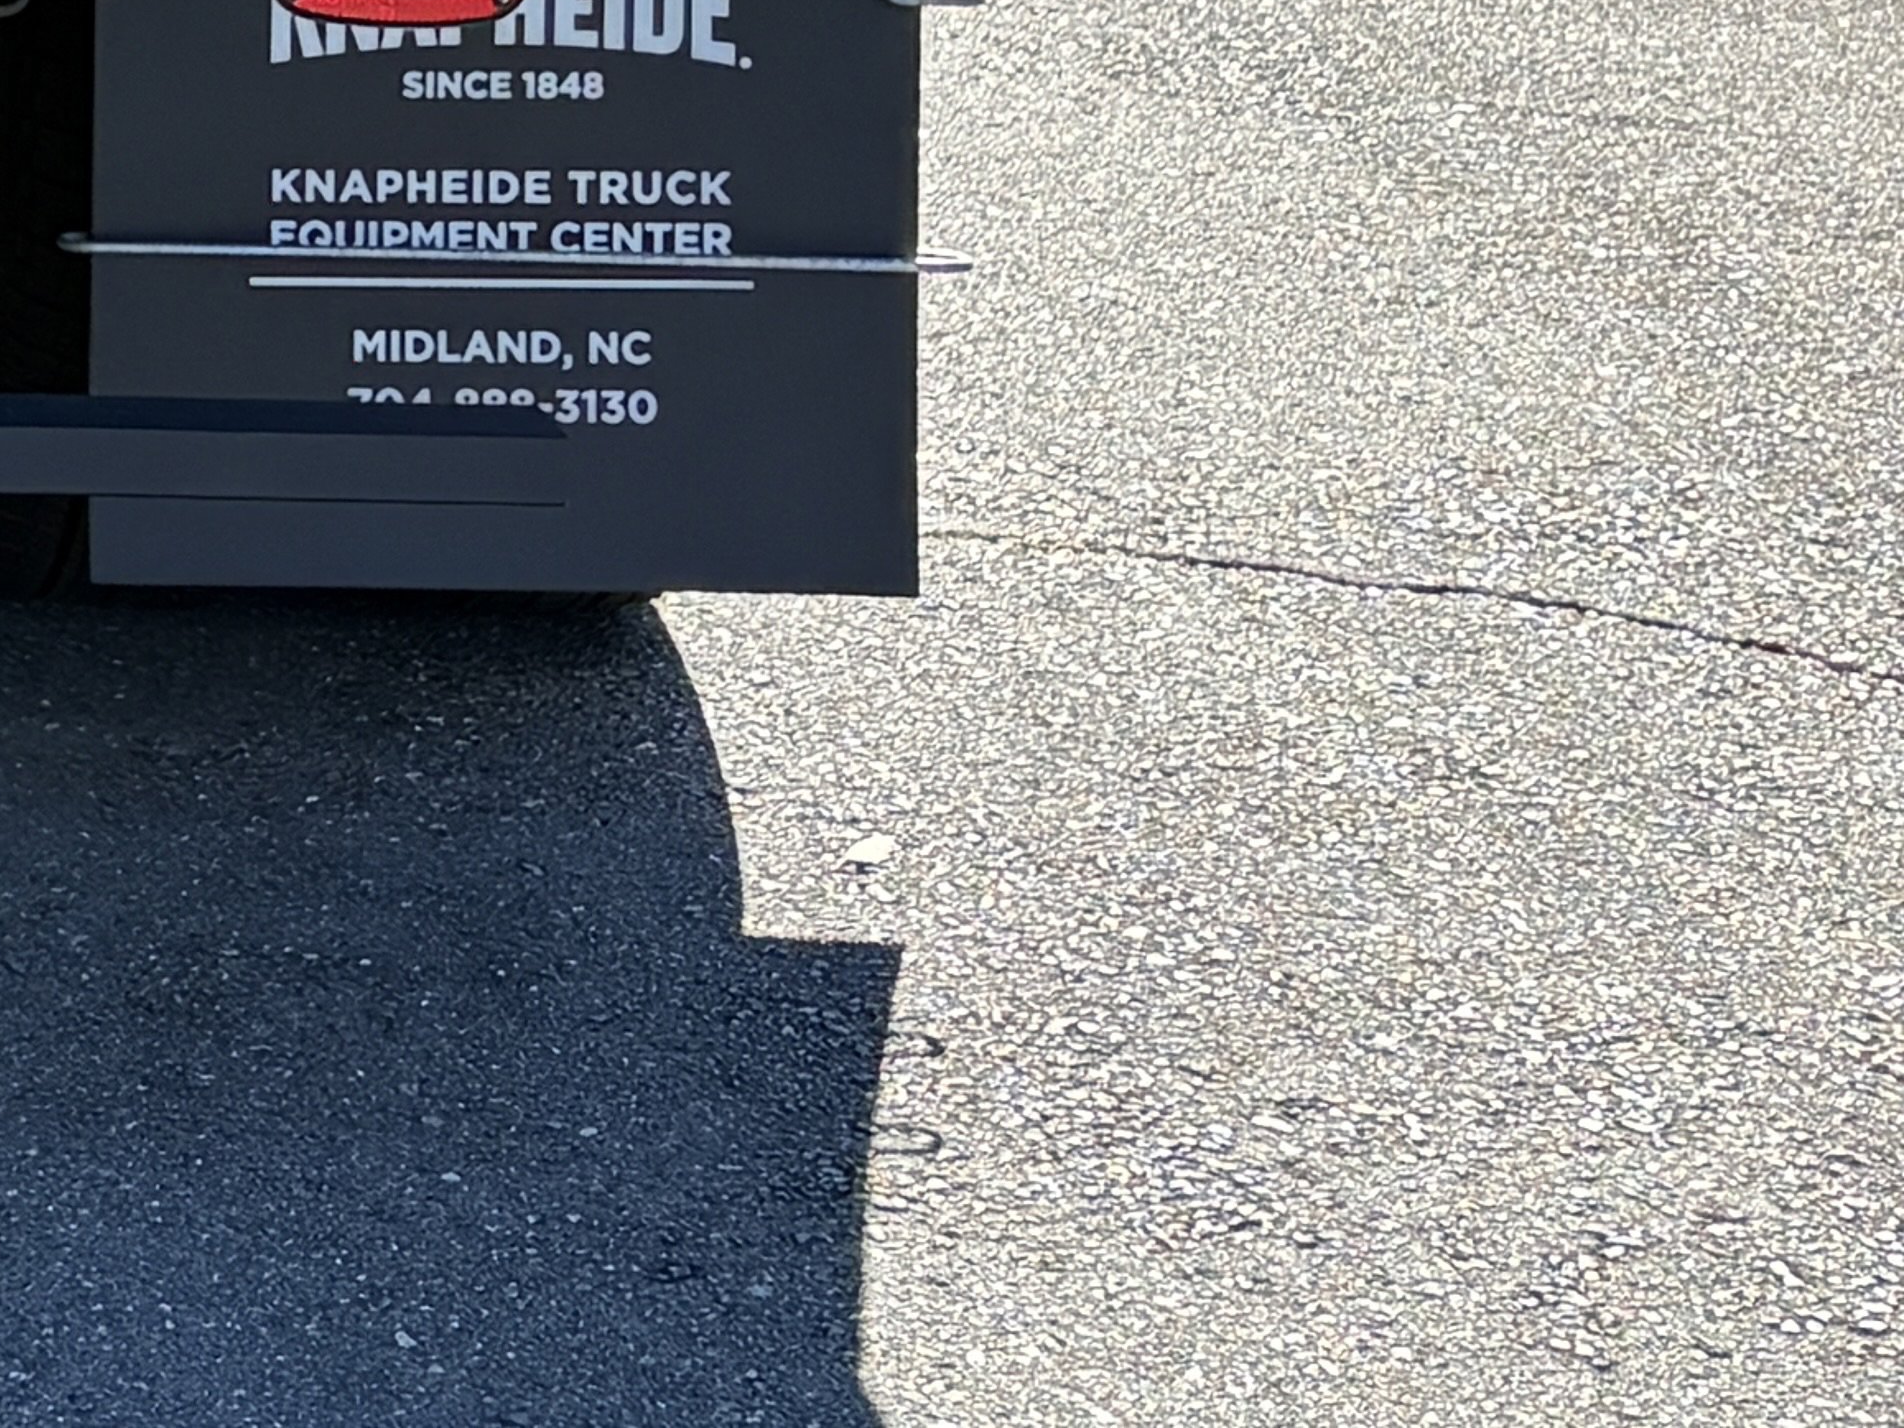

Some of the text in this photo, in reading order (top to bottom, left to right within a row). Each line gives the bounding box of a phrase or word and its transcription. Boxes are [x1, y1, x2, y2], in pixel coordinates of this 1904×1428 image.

[401, 70, 605, 101] SINCE 1848
[270, 168, 733, 207] KNAPHEIDE TRUCK
[269, 218, 733, 256] EQUIPMENT CENTER
[352, 328, 653, 371] MIDLAND, NC
